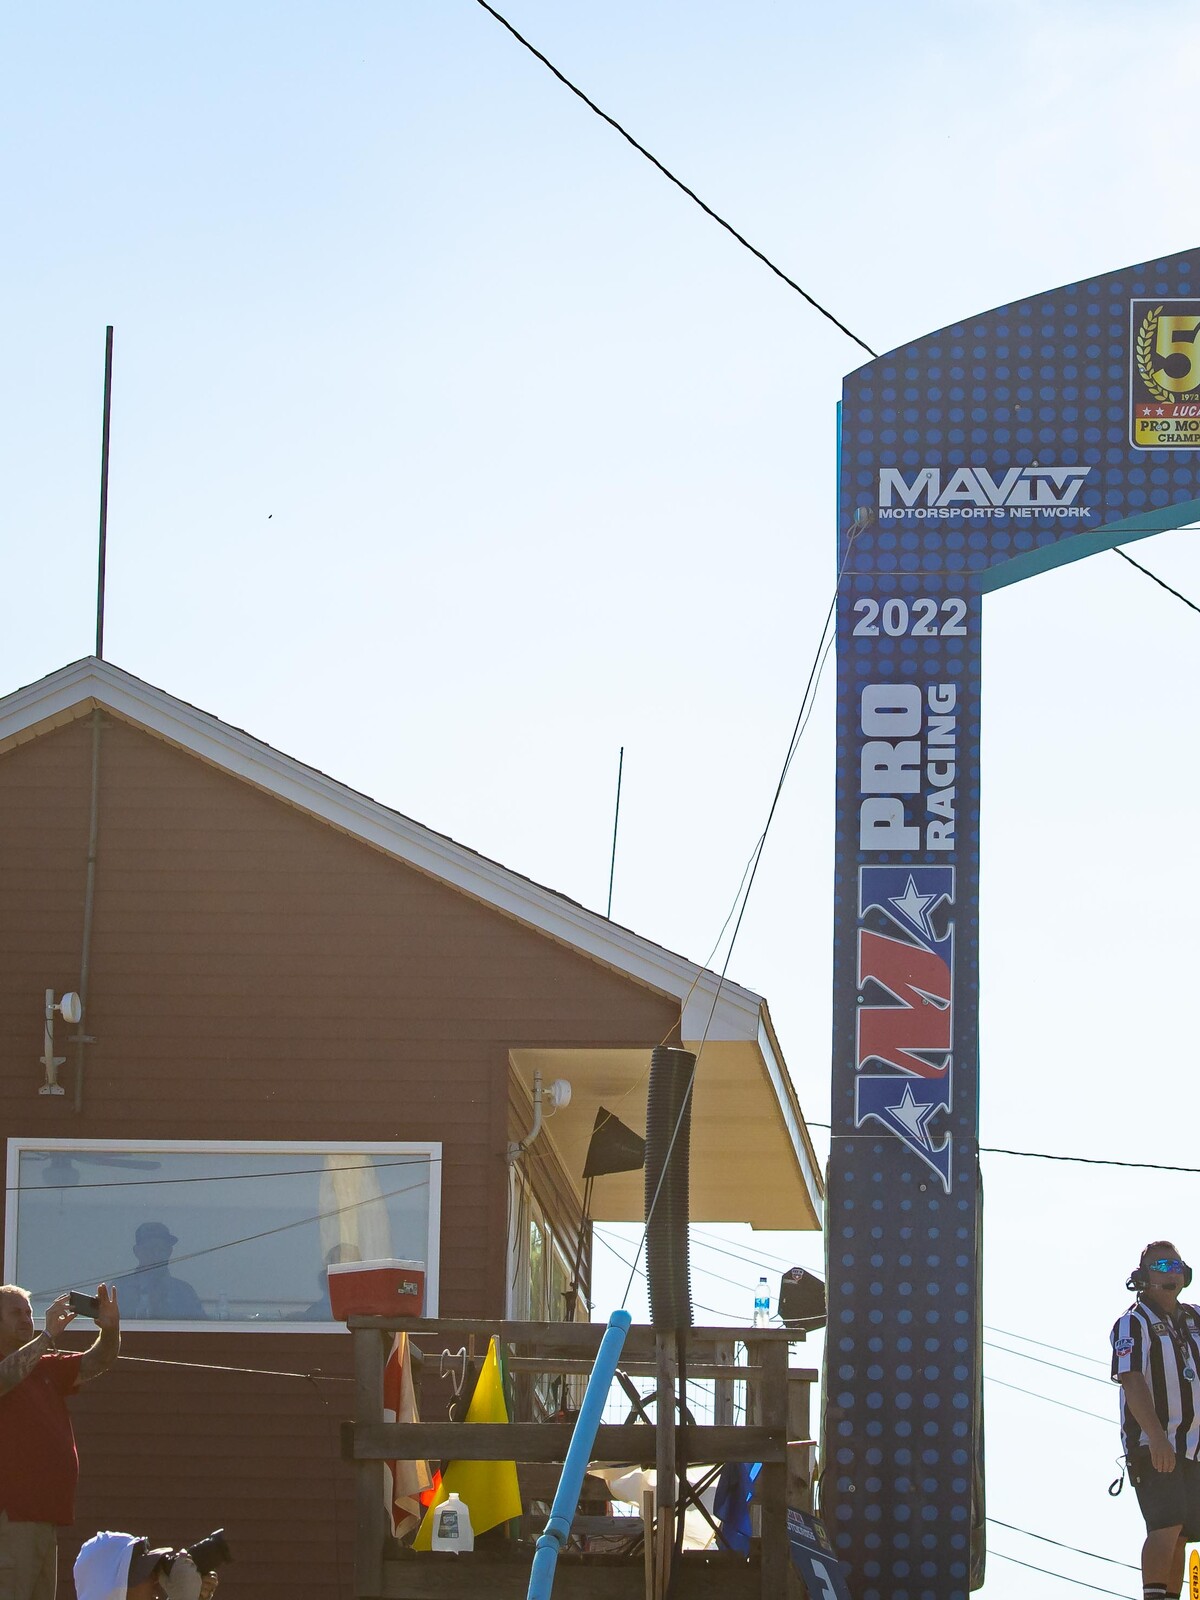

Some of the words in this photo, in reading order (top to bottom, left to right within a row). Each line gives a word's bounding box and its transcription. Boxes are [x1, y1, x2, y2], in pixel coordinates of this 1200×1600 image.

[1140, 420, 1171, 432] PRO
[879, 507, 1005, 519] MOTORSPORTS
[1010, 506, 1092, 518] NETWORK
[852, 598, 968, 637] 2022
[859, 683, 922, 851] PRO
[926, 683, 957, 851] RACING
[853, 864, 957, 1195] AMA
